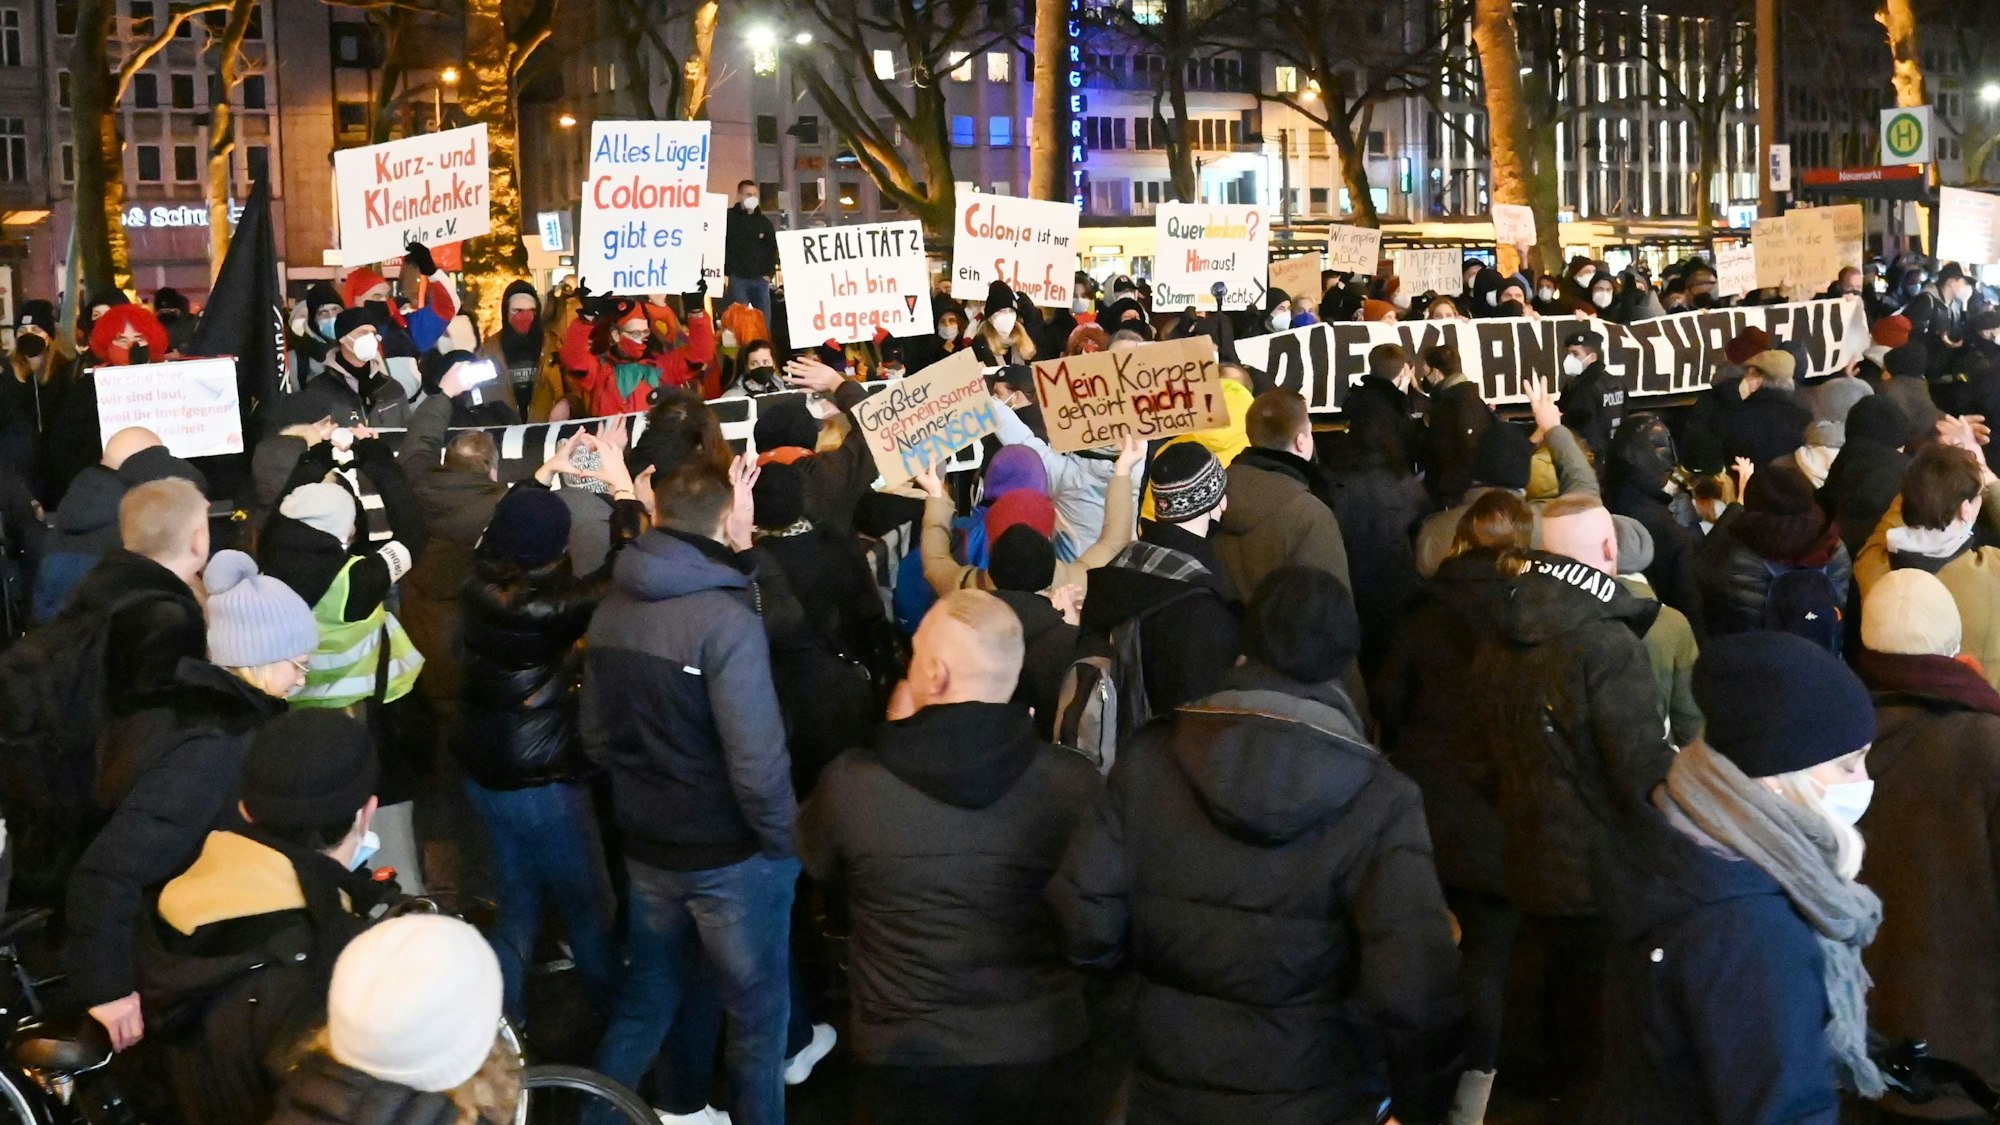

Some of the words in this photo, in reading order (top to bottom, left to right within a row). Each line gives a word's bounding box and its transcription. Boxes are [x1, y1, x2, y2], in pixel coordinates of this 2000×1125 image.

[375, 152, 434, 184] Kurz-
[440, 138, 475, 169] und
[594, 133, 650, 163] Alles
[655, 132, 708, 171] Lüge!
[1838, 169, 1882, 181] Neumarkt
[594, 175, 700, 210] Colonia
[436, 217, 457, 238] e.V.
[604, 221, 647, 260] gibt
[653, 228, 683, 247] es
[965, 203, 1031, 248] Colonia
[1038, 228, 1051, 244] ist
[1054, 235, 1069, 247] nur
[1331, 229, 1347, 242] Wir
[613, 258, 668, 288] nicht
[1332, 253, 1368, 266] ALLE
[1403, 251, 1457, 269] IMPFEN
[831, 270, 857, 297] Ich
[866, 267, 897, 294] bin
[959, 266, 980, 281] ein
[988, 258, 1066, 301] Schnupfen
[100, 375, 121, 388] Wir
[127, 372, 153, 385] sind
[1035, 361, 1109, 407] Mein
[1113, 353, 1213, 393] Körper
[101, 395, 121, 405] wir
[127, 390, 152, 402] sind
[157, 388, 186, 401] laut,
[859, 381, 931, 432] Größter
[1058, 389, 1126, 429] gehört
[1131, 380, 1194, 414] nicht
[102, 412, 130, 423] weil
[156, 423, 205, 436] Freiheit
[880, 377, 985, 452] gemeinsamer
[902, 402, 998, 476] MENSCH
[1082, 420, 1130, 443] dem
